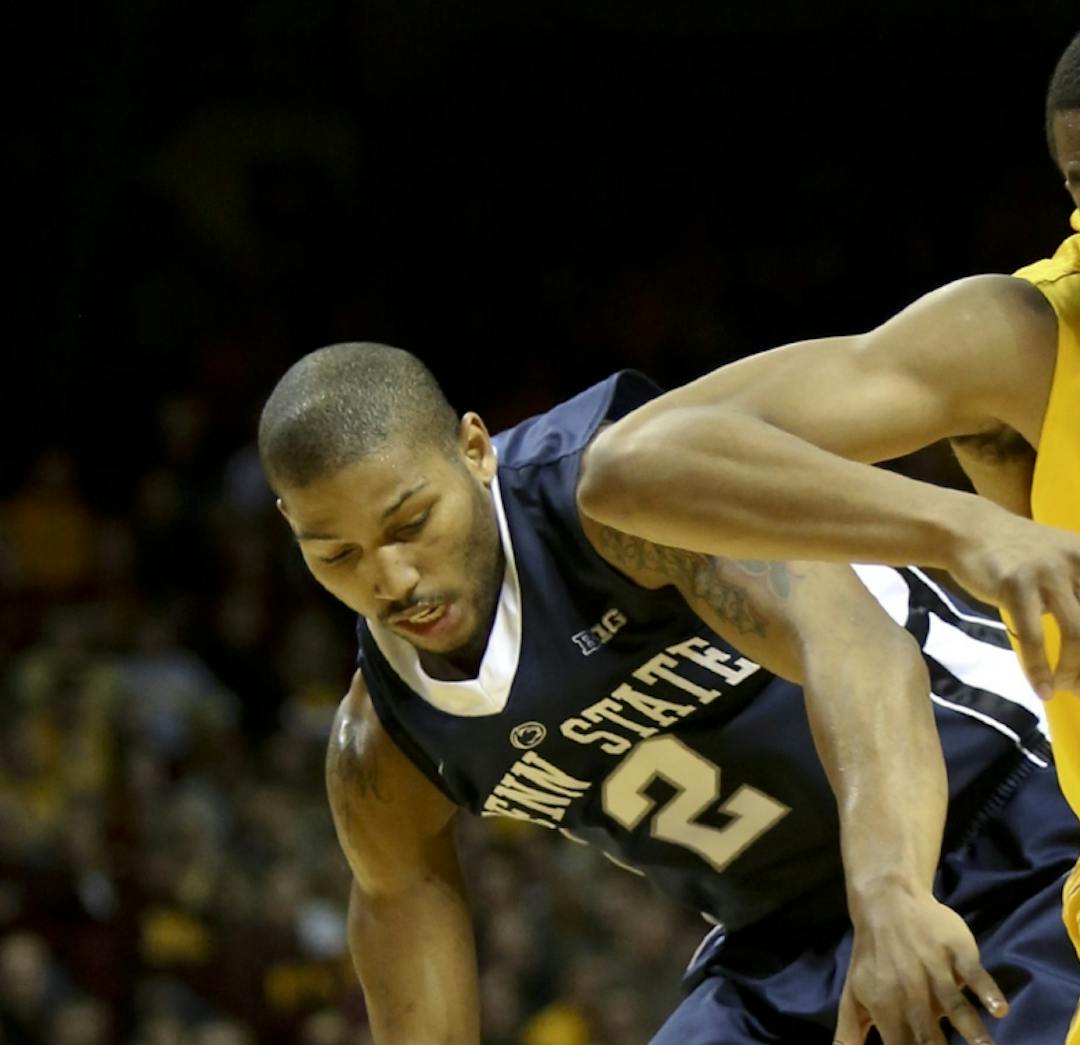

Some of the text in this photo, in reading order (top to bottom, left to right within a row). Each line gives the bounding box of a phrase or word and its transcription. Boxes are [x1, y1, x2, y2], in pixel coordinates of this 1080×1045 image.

[481, 636, 761, 829] ENN STATE
[601, 733, 793, 873] 2
